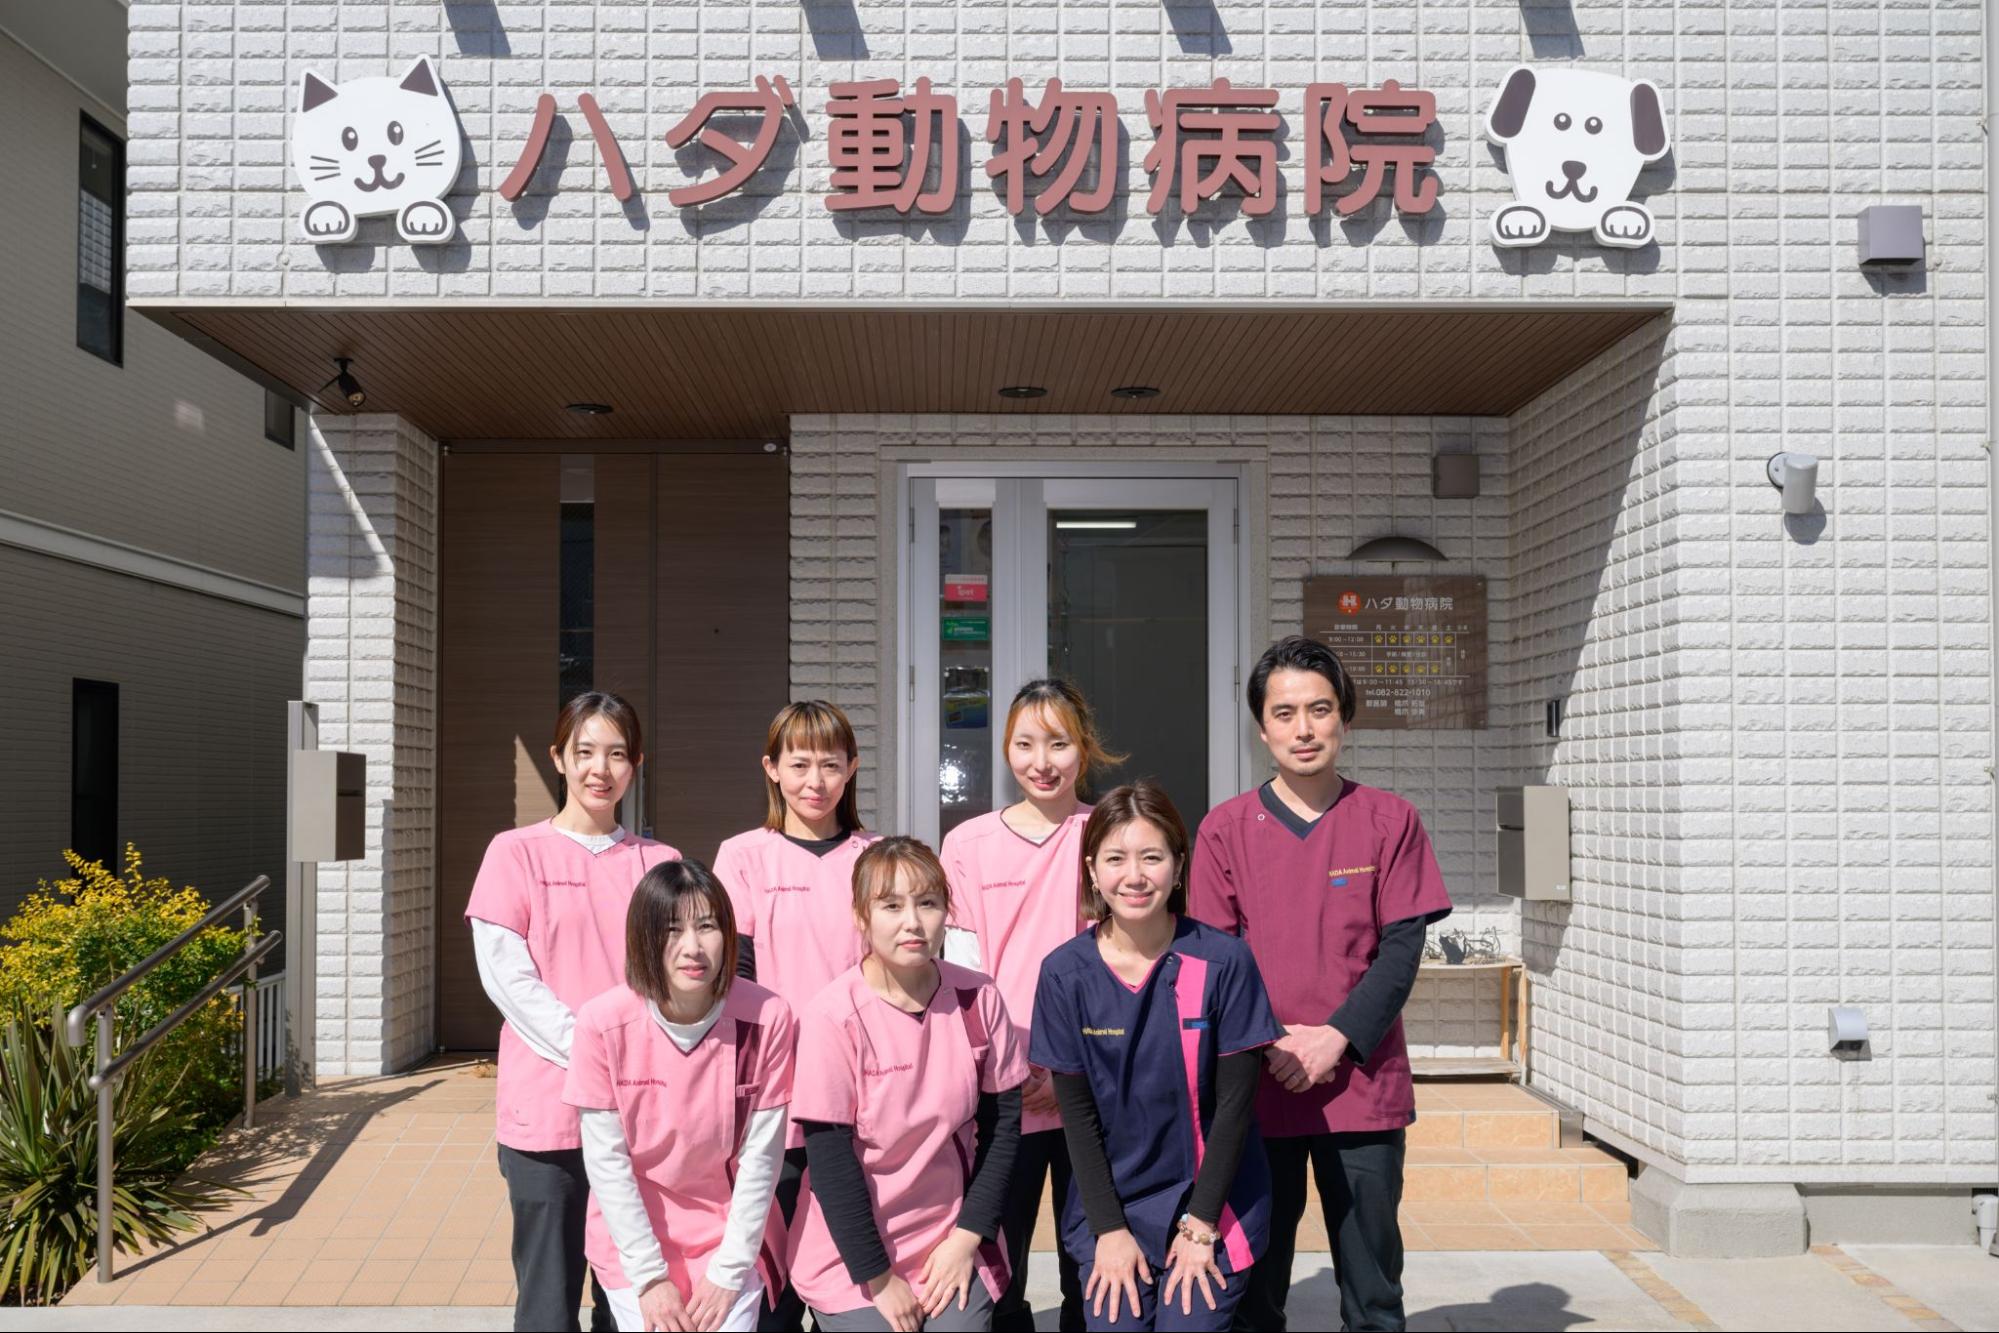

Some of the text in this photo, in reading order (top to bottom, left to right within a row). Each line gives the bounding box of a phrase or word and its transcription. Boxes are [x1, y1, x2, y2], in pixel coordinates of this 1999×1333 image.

[500, 74, 1437, 215] ハダ動物病院
[1365, 597, 1454, 610] ハダ動物病院
